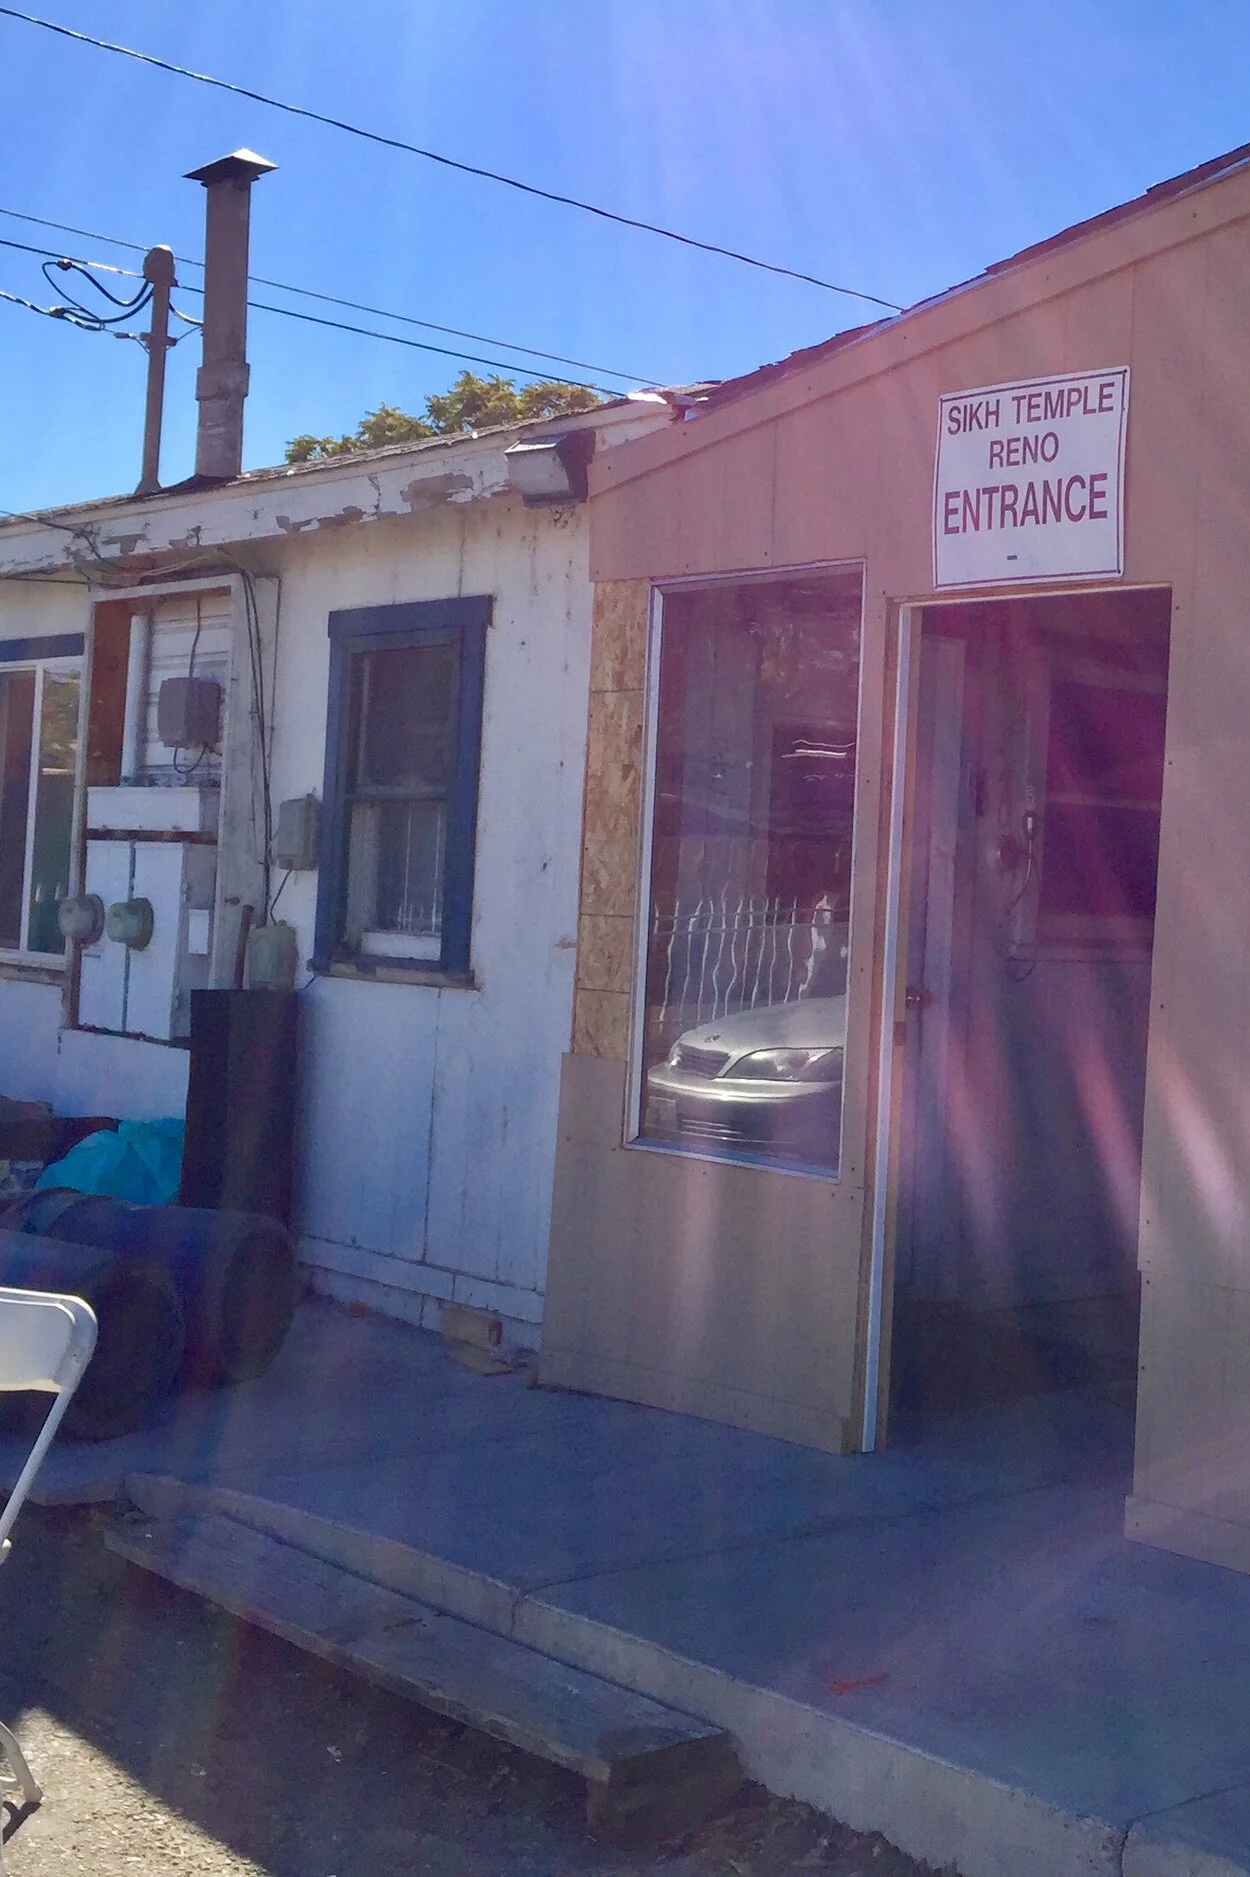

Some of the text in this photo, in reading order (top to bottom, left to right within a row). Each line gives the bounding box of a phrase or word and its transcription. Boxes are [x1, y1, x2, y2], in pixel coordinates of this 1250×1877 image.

[948, 382, 1115, 435] SIKH TEMPLE
[989, 432, 1059, 469] RENO
[944, 473, 1107, 535] ENTRANCE
